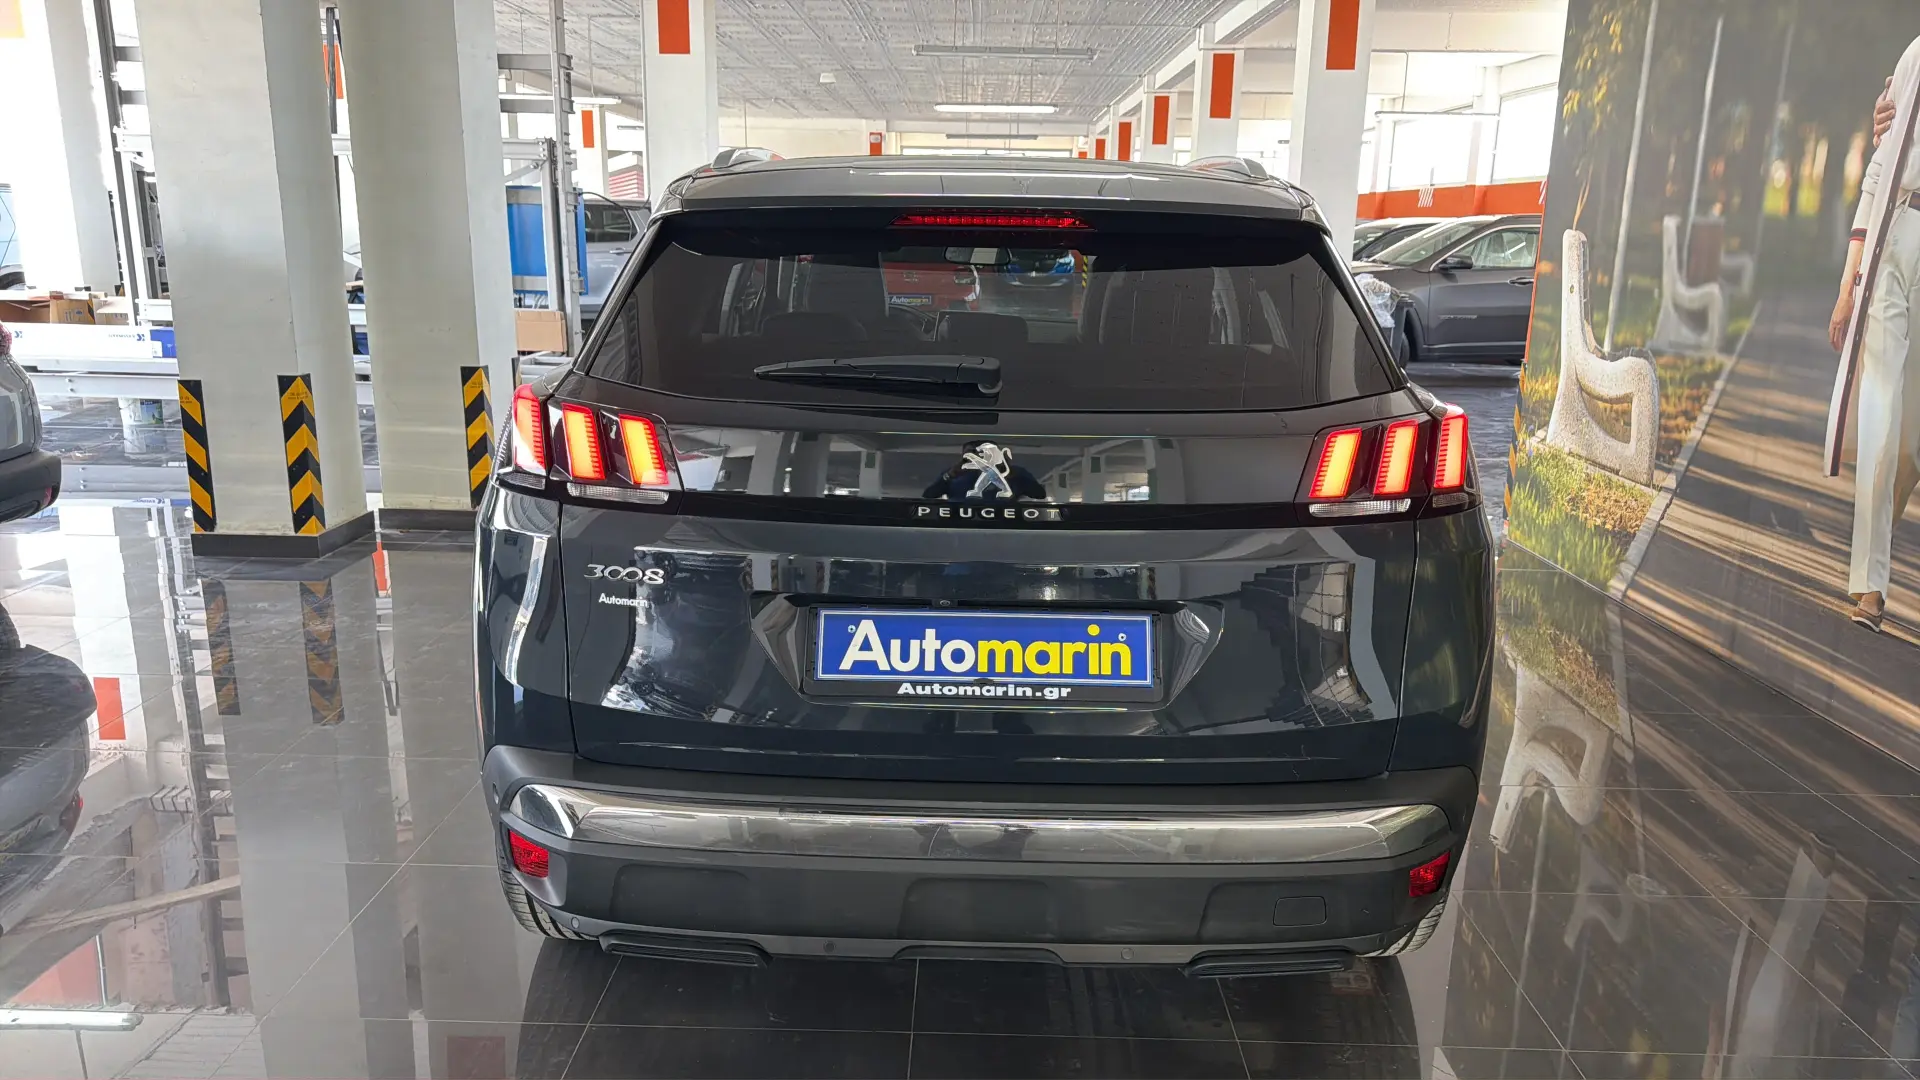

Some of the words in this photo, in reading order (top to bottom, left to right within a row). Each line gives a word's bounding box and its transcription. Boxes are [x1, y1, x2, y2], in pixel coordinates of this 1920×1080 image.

[917, 506, 1060, 519] PEUGEOT
[583, 564, 665, 585] 3008
[598, 592, 648, 608] Automarin
[838, 619, 1132, 676] Automarin
[897, 682, 1072, 700] Automarin.gr
